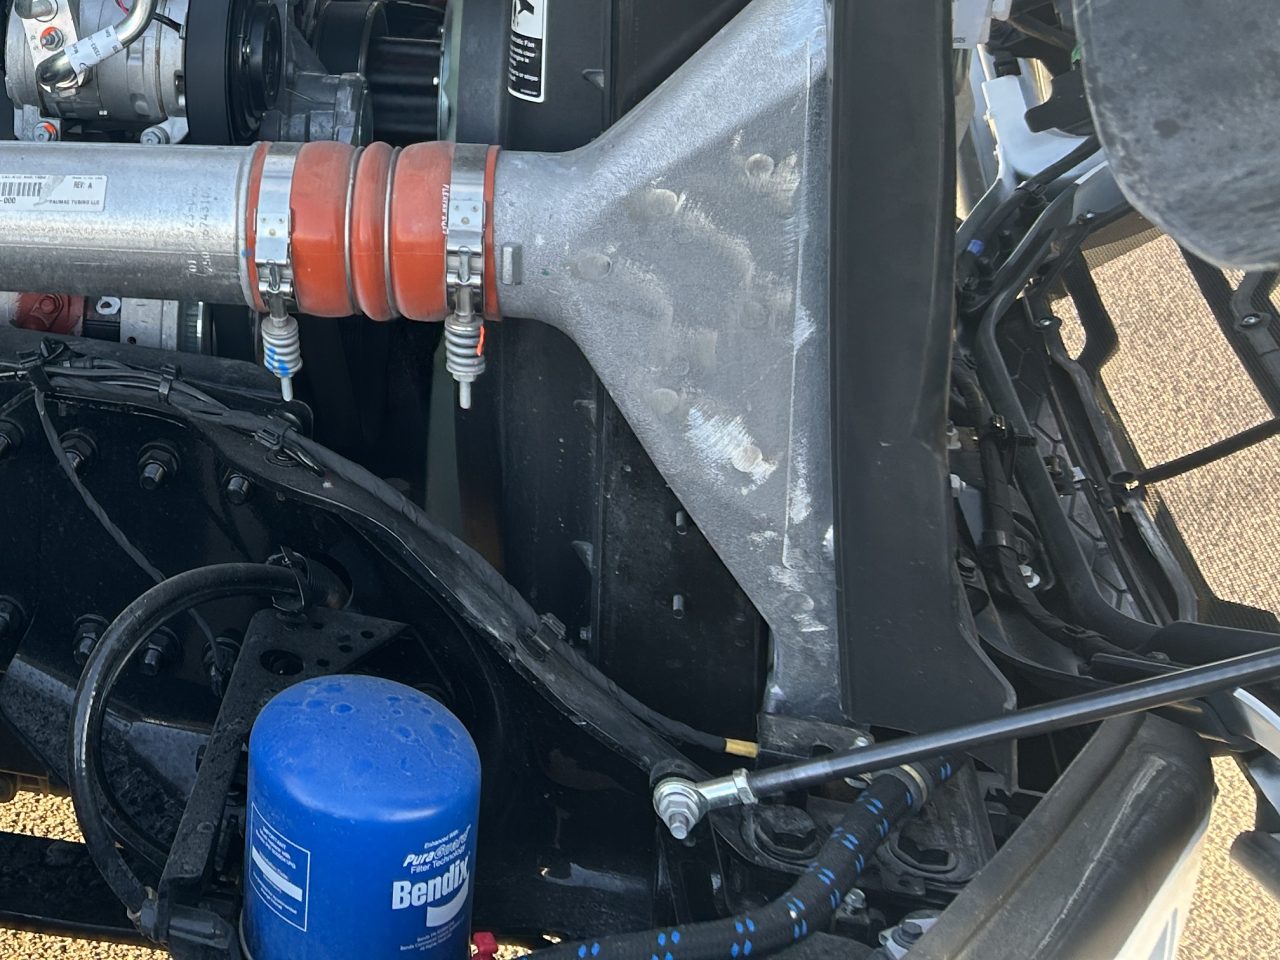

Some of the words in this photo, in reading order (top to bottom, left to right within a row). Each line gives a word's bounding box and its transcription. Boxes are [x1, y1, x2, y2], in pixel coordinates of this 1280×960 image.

[424, 835, 449, 849] Enhanced
[410, 863, 431, 875] Filter
[432, 844, 466, 869] Technology
[392, 855, 469, 910] Bendix
